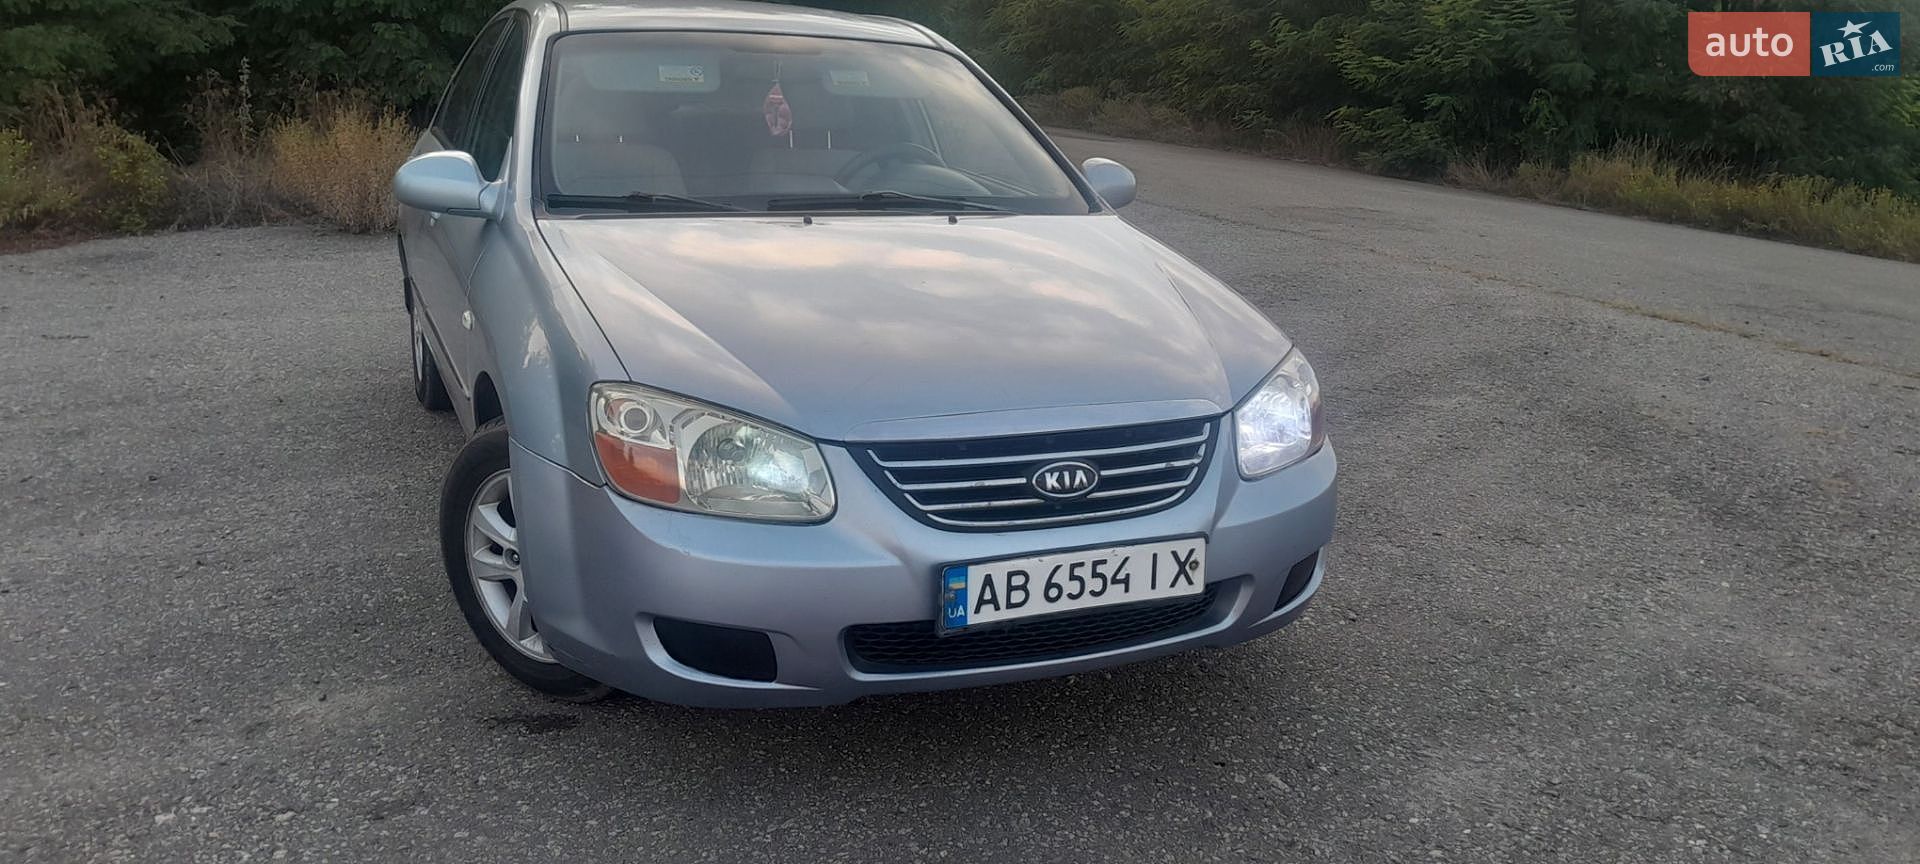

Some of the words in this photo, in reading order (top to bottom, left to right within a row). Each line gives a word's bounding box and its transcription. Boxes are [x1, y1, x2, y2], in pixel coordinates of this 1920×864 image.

[1044, 469, 1088, 491] KIA
[973, 569, 1031, 614] AB
[1043, 556, 1130, 603] 6554
[948, 604, 965, 618] UA
